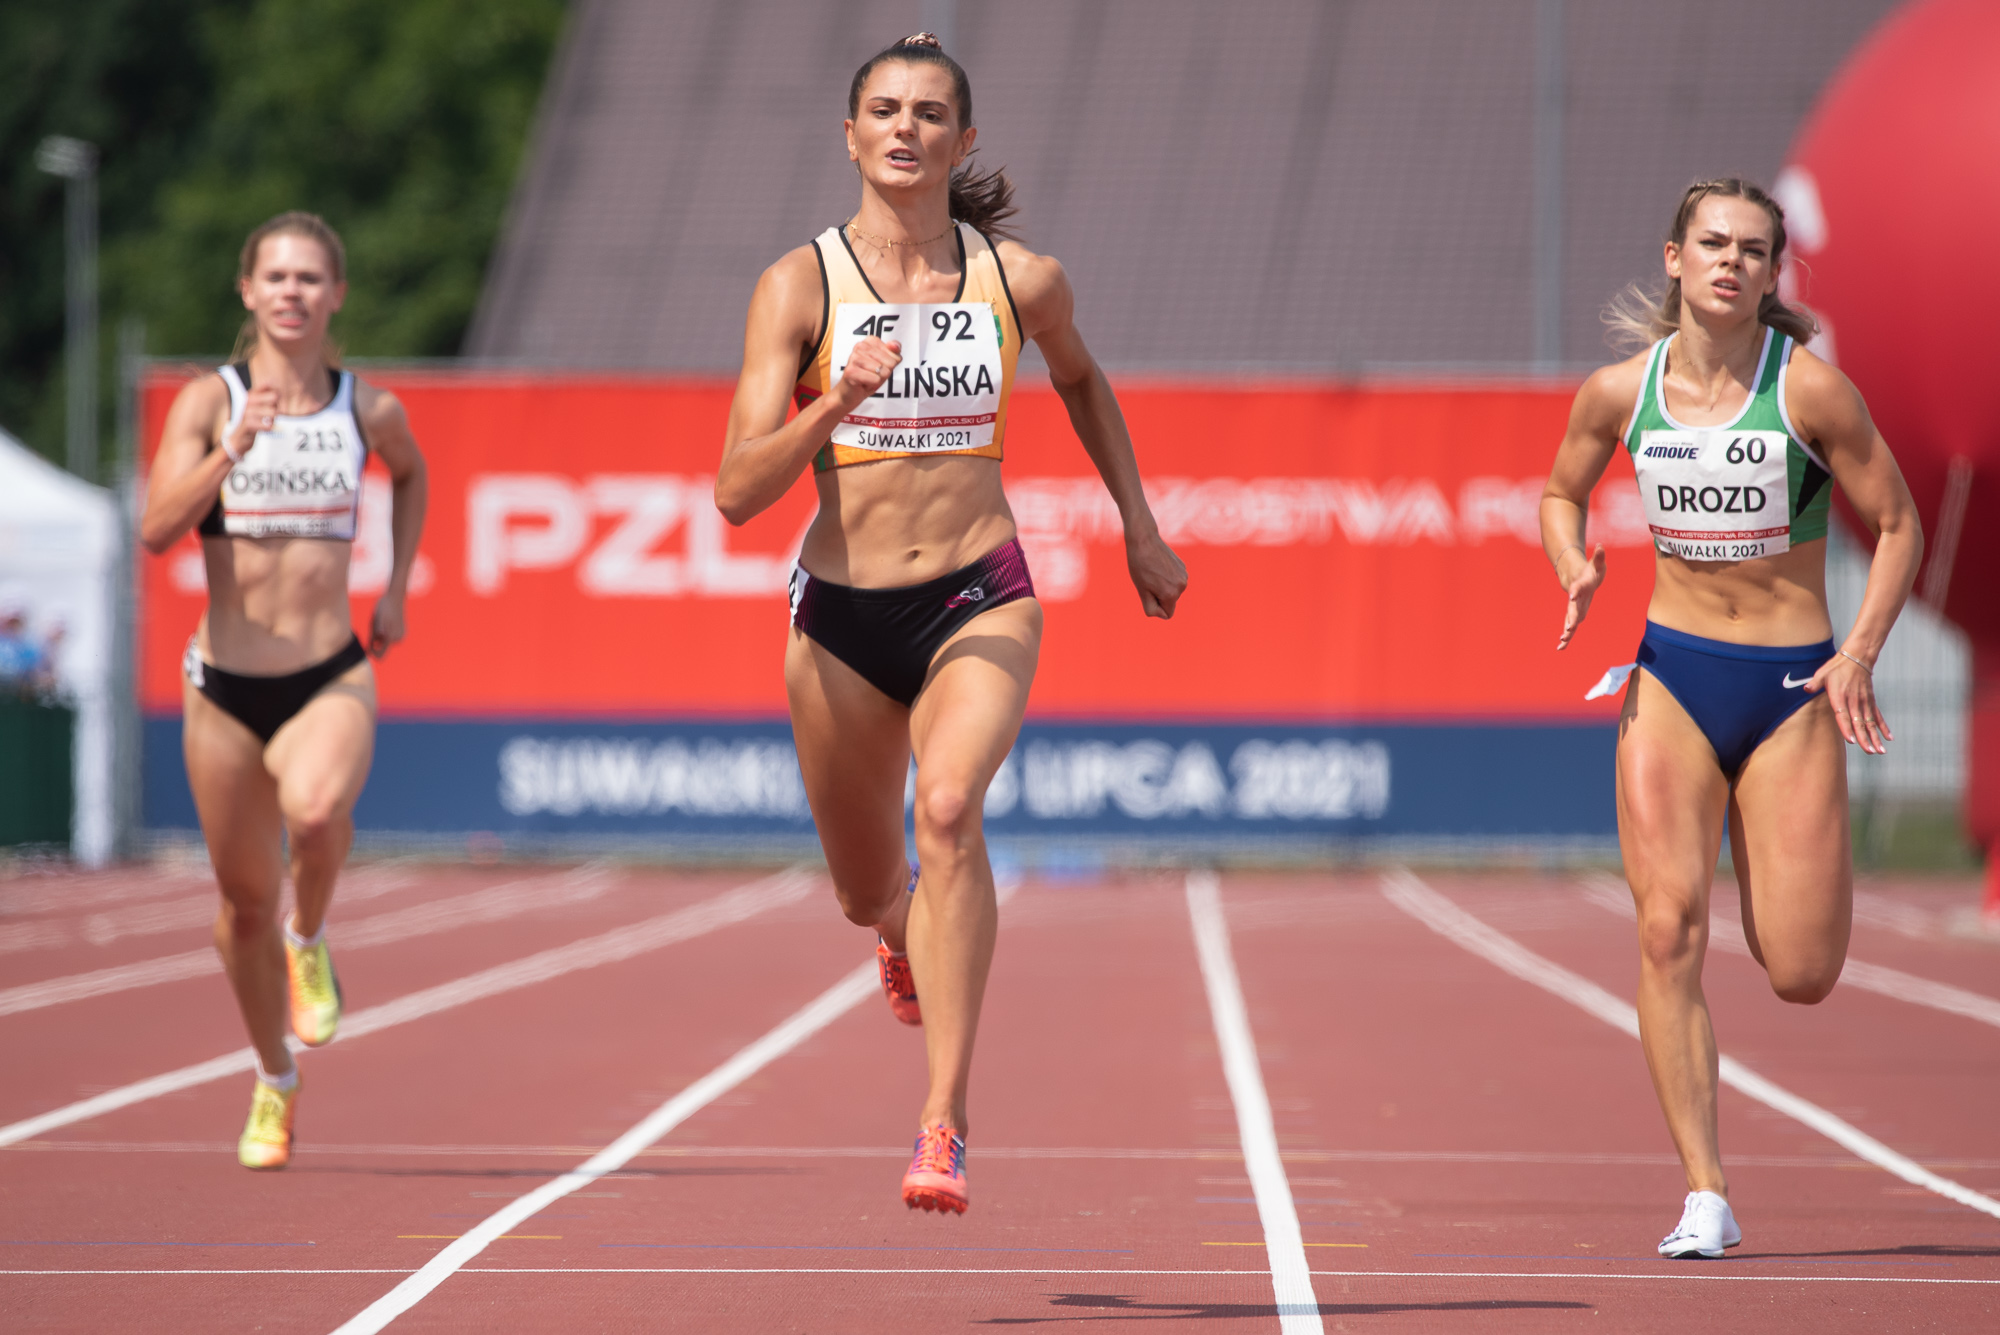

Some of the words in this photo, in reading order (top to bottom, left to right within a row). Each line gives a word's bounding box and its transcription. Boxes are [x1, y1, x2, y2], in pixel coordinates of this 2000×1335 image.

[852, 314, 900, 338] 4F
[931, 310, 975, 342] 92
[840, 360, 994, 398] LIŃSKA
[853, 418, 878, 427] PZLA
[878, 419, 942, 428] MISTRZOSTWA
[943, 415, 975, 425] POLSKI
[976, 414, 993, 424] U23
[296, 430, 343, 452] 213
[858, 430, 931, 449] SUWAŁKI
[936, 431, 972, 447] 2021
[1725, 437, 1767, 464] 60
[1643, 446, 1699, 460] 4MOVE
[229, 462, 349, 496] OSIŃSKA
[1657, 484, 1767, 513] DROZD
[465, 473, 816, 596] PZL
[1680, 531, 1737, 540] MISTRZOSTWA
[1737, 530, 1767, 539] POLSKI
[1667, 541, 1727, 558] SUWAŁKI
[1731, 542, 1765, 558] 2021
